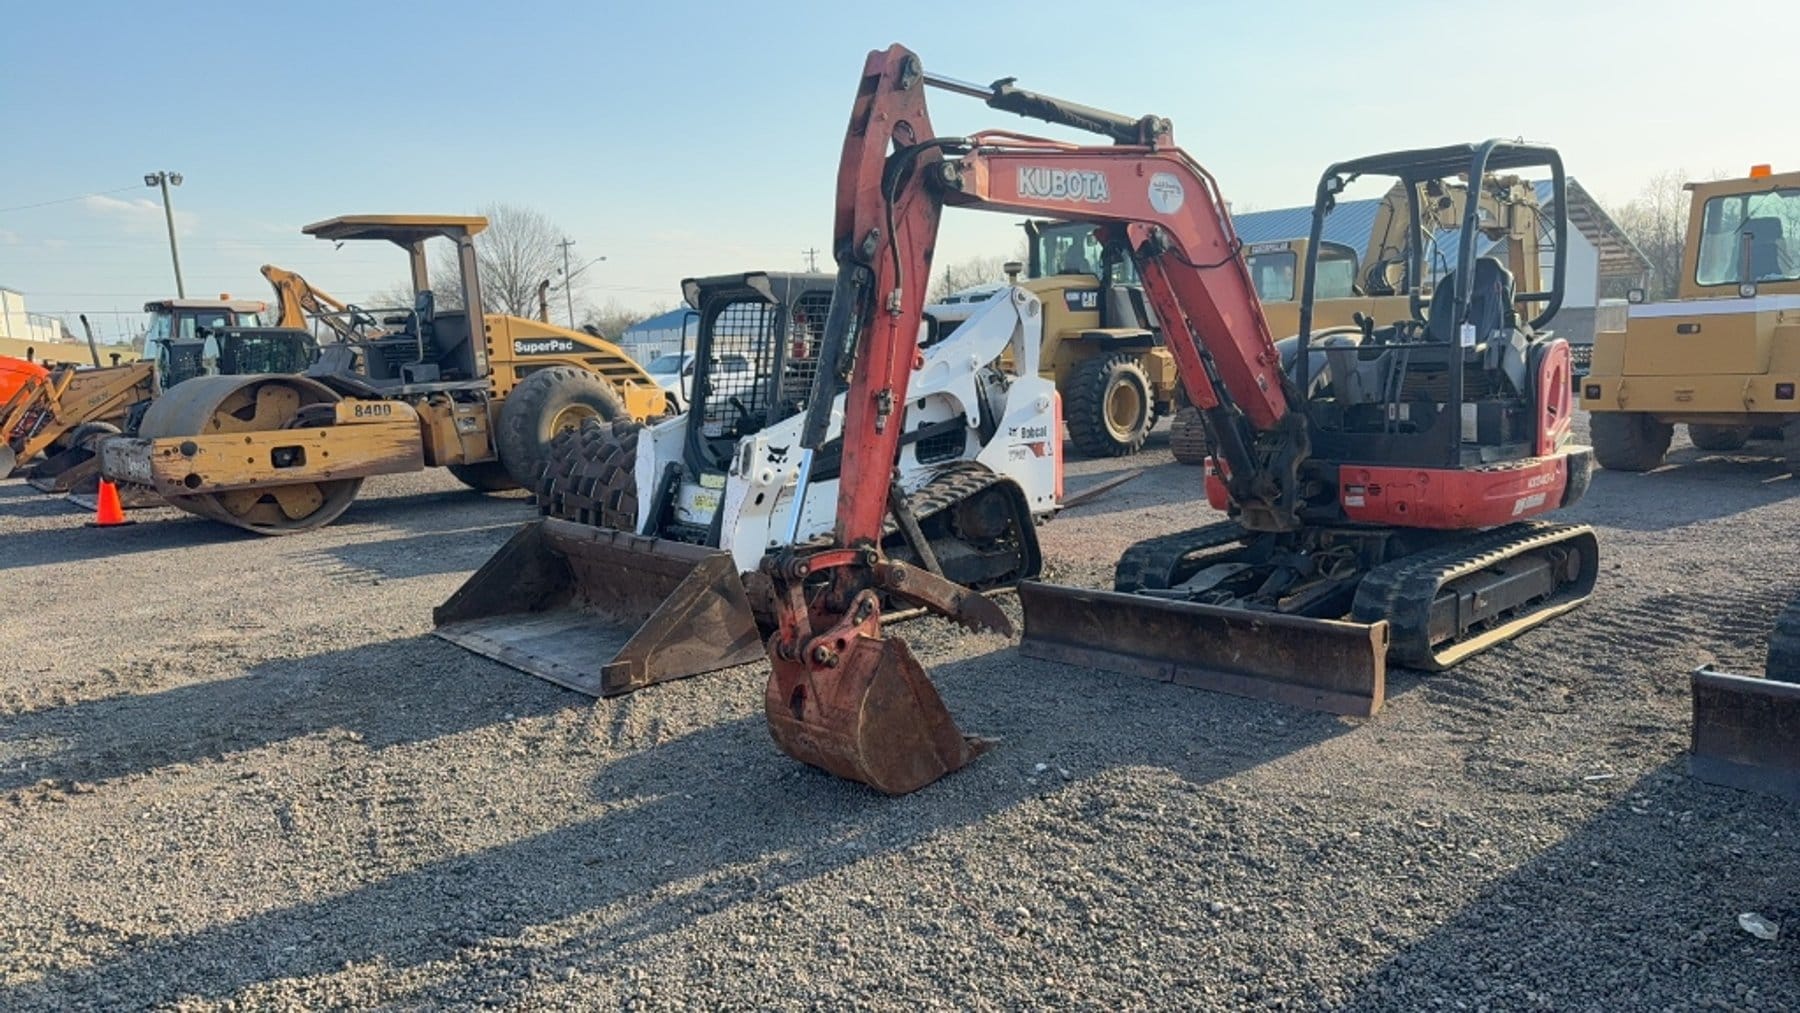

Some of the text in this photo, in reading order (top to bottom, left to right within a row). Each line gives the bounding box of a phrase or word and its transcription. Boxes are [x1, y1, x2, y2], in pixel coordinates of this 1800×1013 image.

[1018, 167, 1109, 201] KUBOTA
[1081, 291, 1098, 308] CAT
[514, 340, 573, 354] SuperPac
[354, 404, 392, 417] 8400
[1021, 425, 1047, 439] Bobcat
